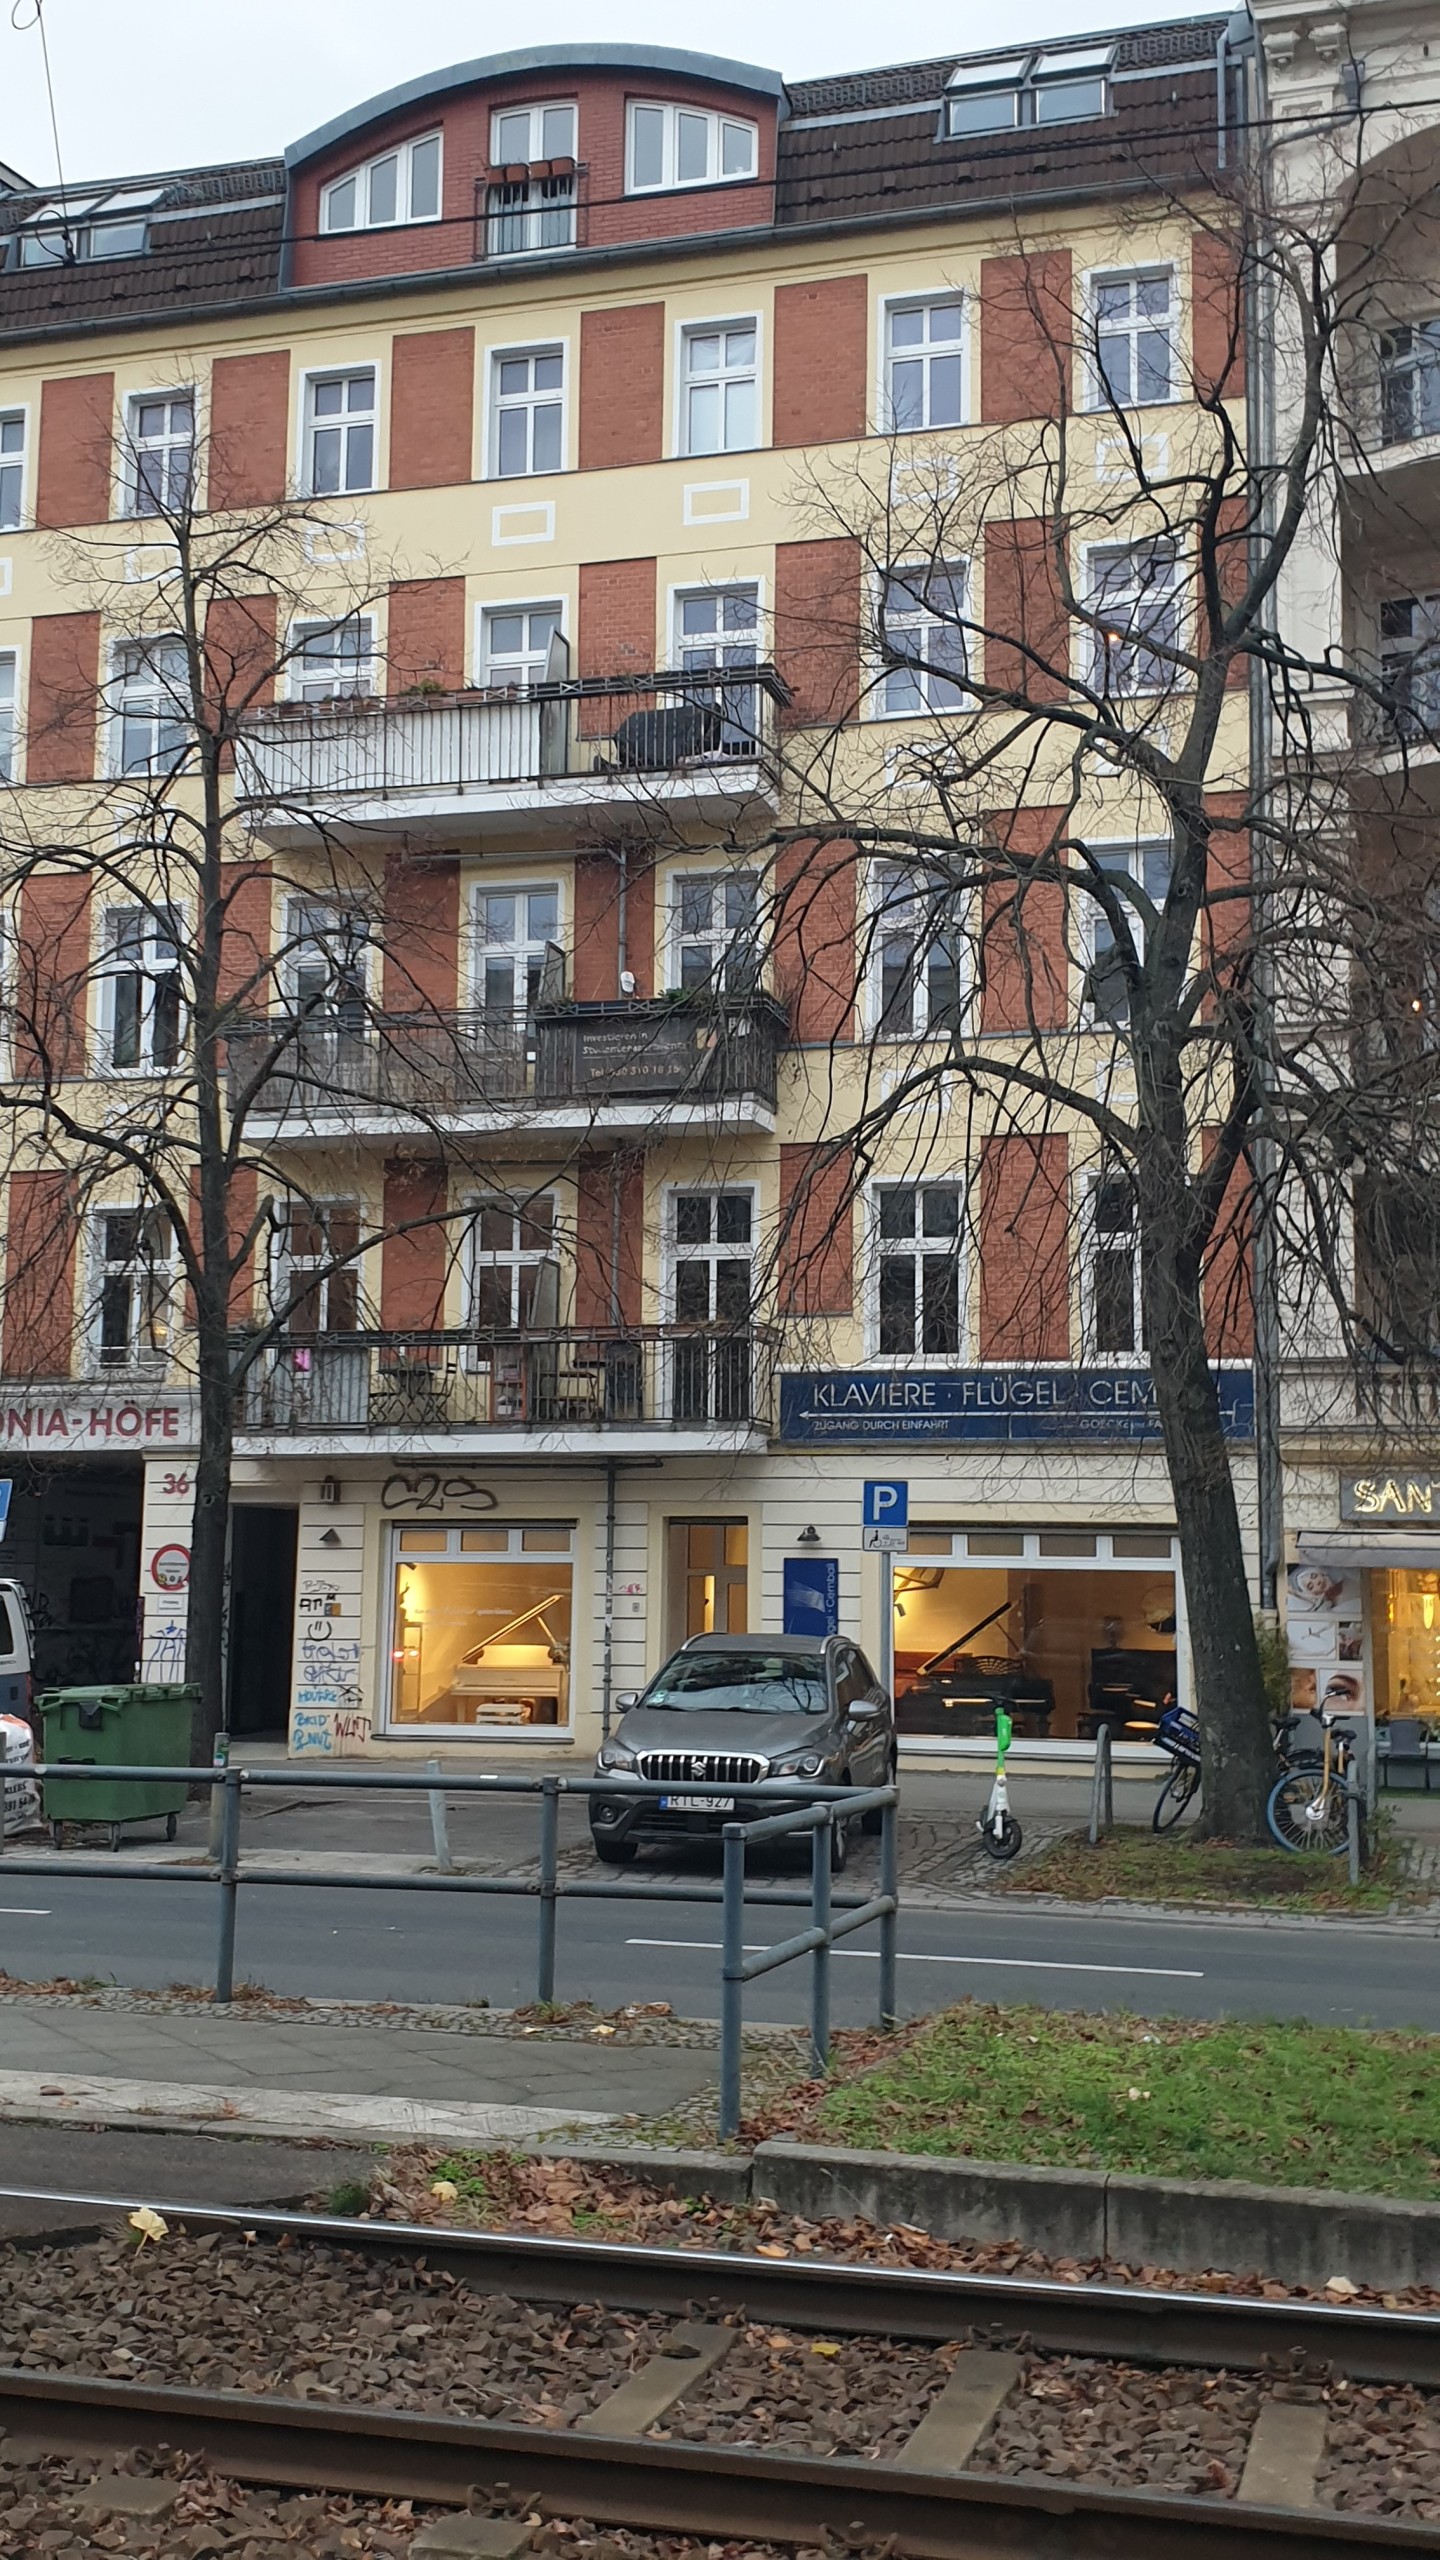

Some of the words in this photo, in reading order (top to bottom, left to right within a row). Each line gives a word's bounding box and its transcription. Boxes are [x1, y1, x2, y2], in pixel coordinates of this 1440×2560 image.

[813, 1382, 937, 1407] KLAVIERE
[962, 1377, 1063, 1406] FLÜGEL
[0, 1400, 180, 1438] NIA-HÖFE
[814, 1420, 860, 1431] ZUGANG
[862, 1420, 901, 1431] DURCH
[902, 1419, 950, 1431] EINFAHRT
[163, 1473, 190, 1495] 36
[1353, 1479, 1440, 1513] SAN
[872, 1485, 898, 1521] P
